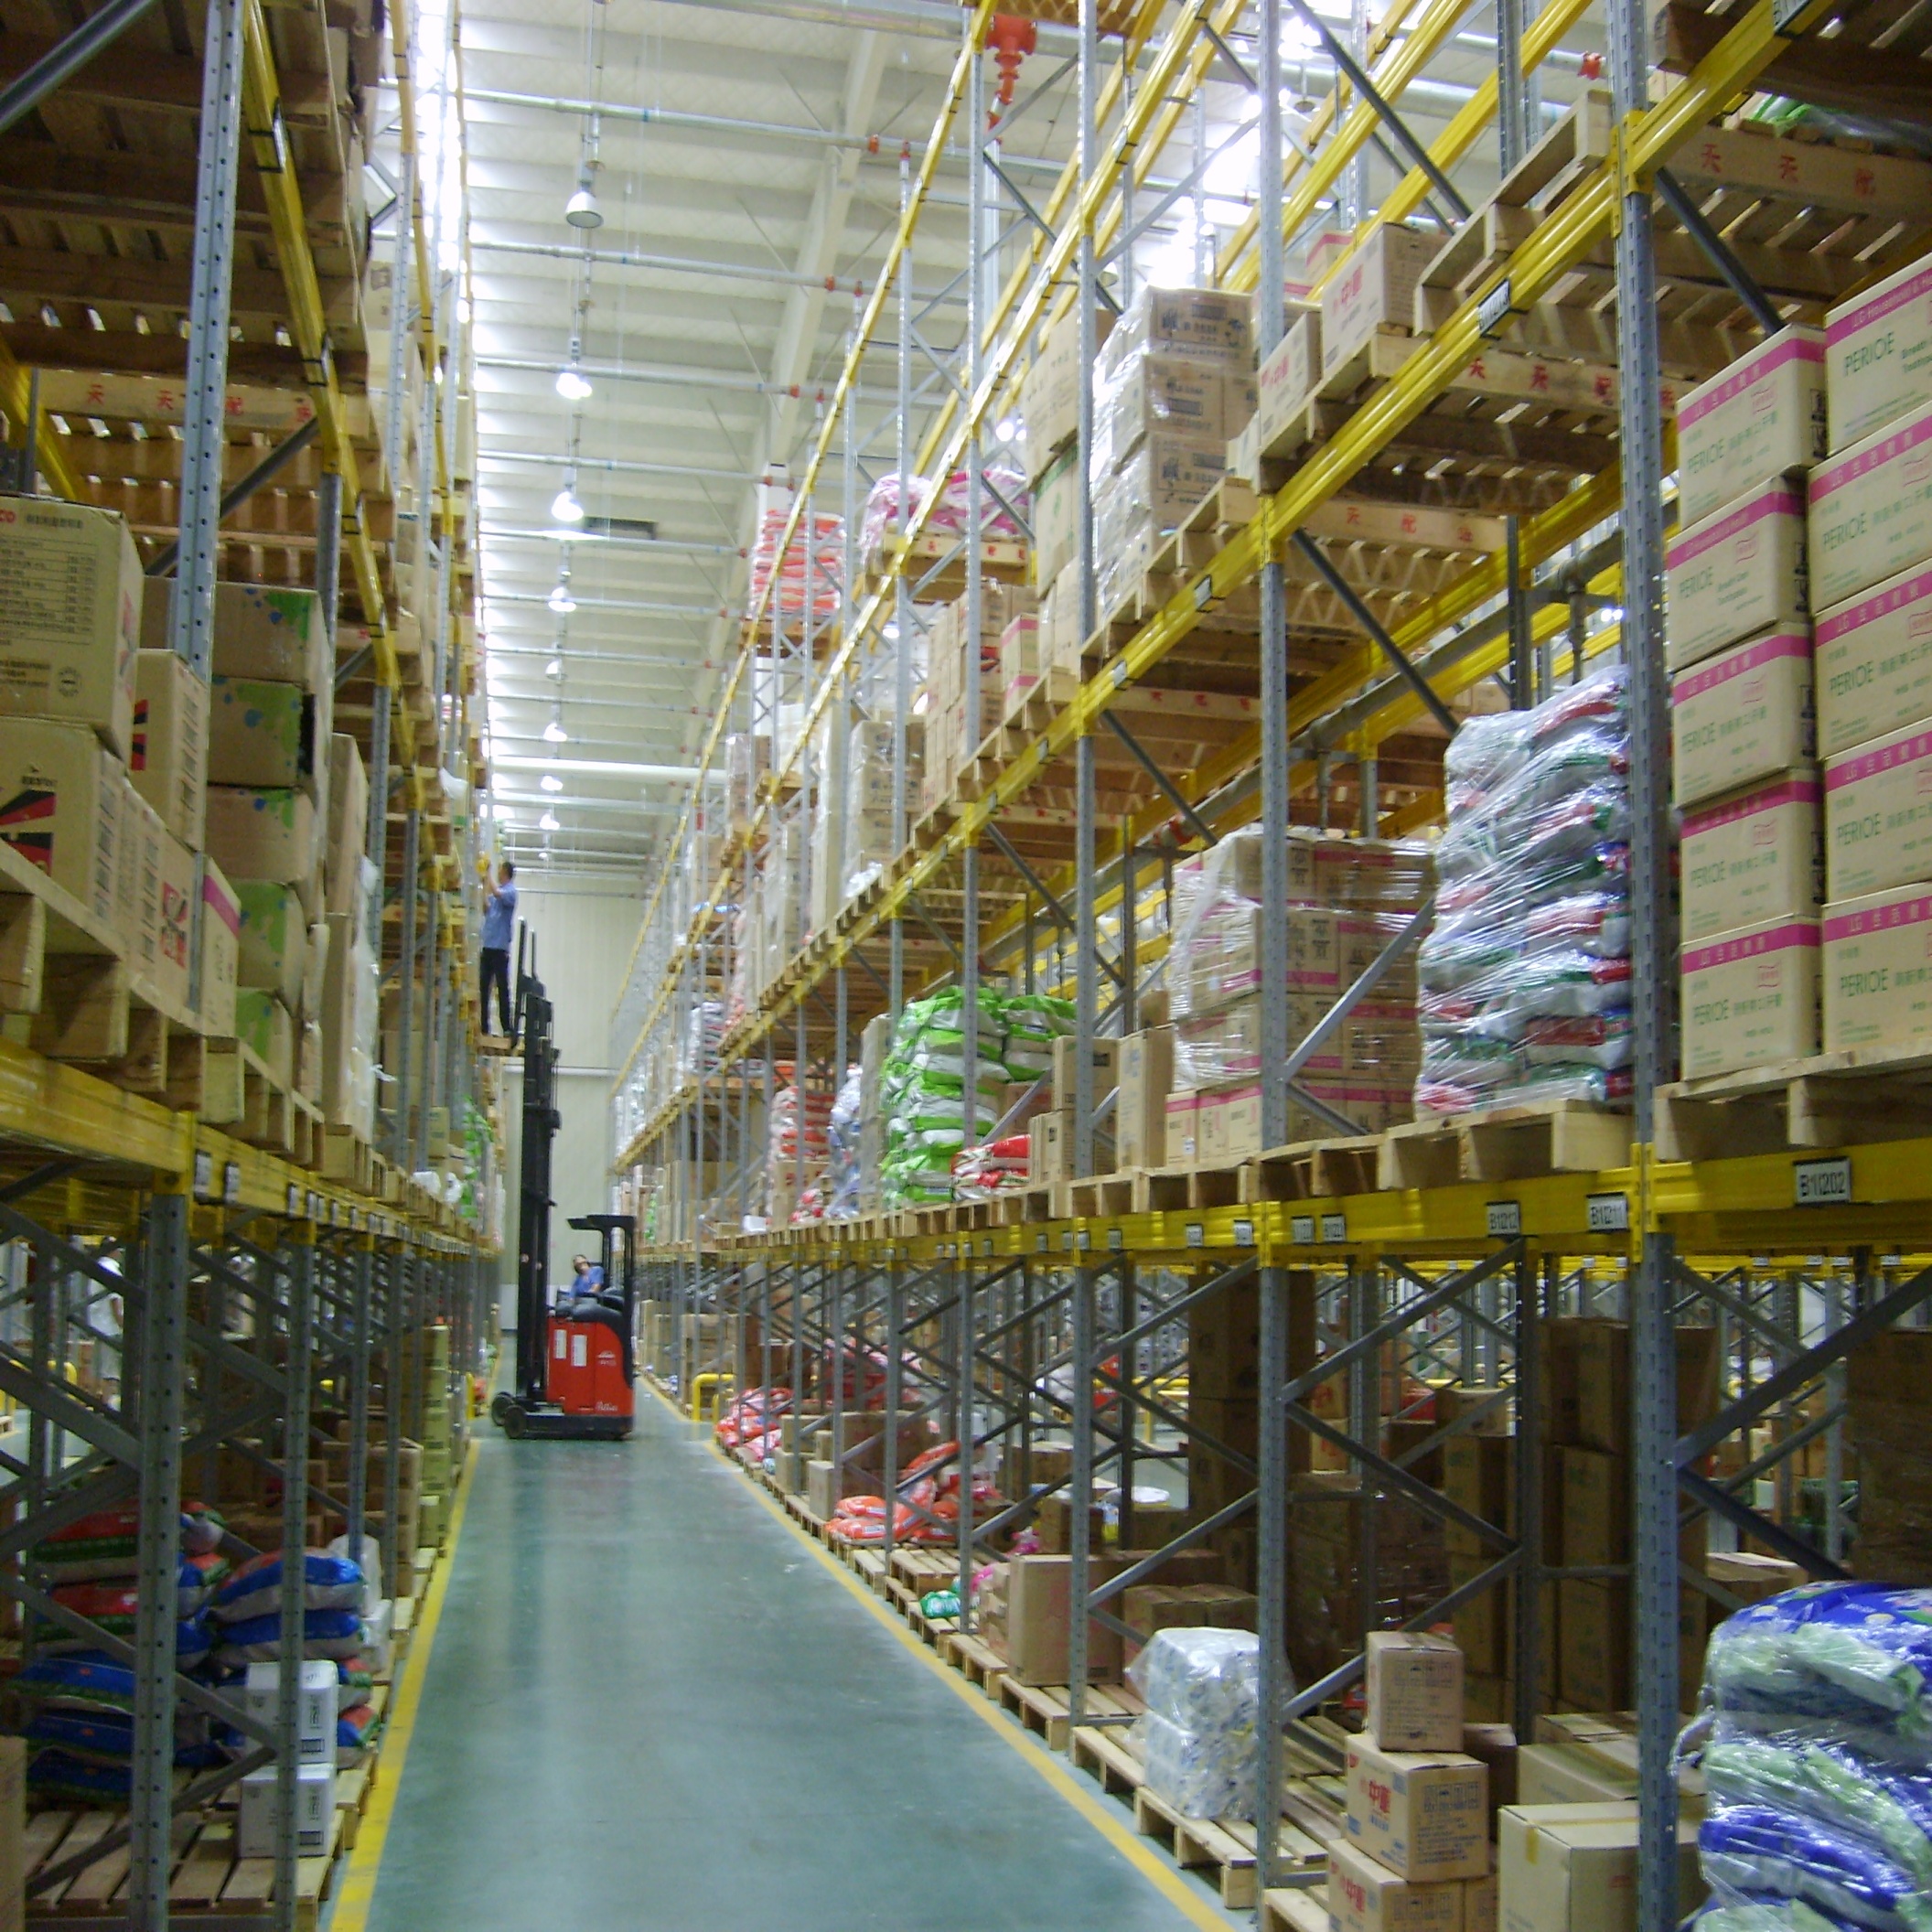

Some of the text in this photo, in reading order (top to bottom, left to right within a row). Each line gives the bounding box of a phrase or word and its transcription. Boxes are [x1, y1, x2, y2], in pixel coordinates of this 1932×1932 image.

[1844, 331, 1895, 378] PERIOE
[1688, 438, 1724, 474] PERIOE
[1823, 511, 1868, 552] PERIOE
[1830, 660, 1874, 698] PERIOE
[1836, 811, 1882, 846] PERIOE
[1841, 968, 1889, 998] PERIOE
[1693, 998, 1729, 1025] PERIOE
[1799, 1172, 1846, 1197] B11202
